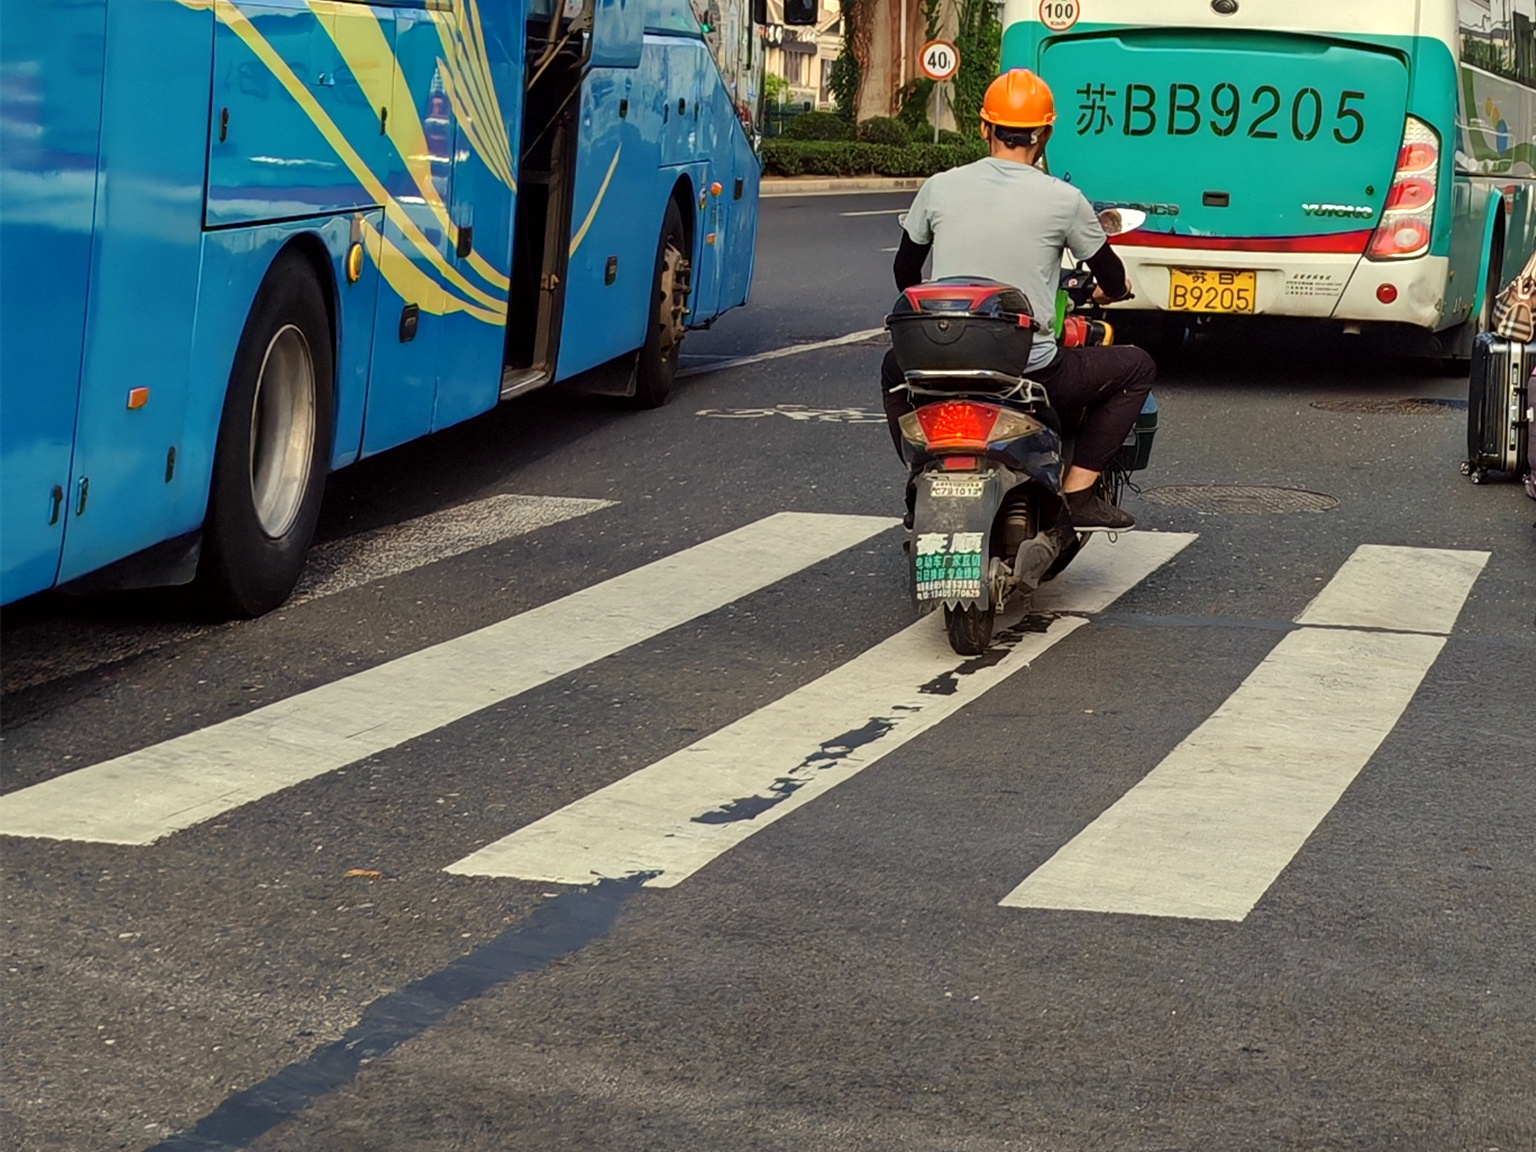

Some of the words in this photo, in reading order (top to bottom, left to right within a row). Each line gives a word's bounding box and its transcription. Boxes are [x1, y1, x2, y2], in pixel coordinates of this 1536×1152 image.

[1045, 3, 1073, 19] 100
[1075, 81, 1367, 145] 苏BB9205
[1173, 284, 1250, 311] B9205
